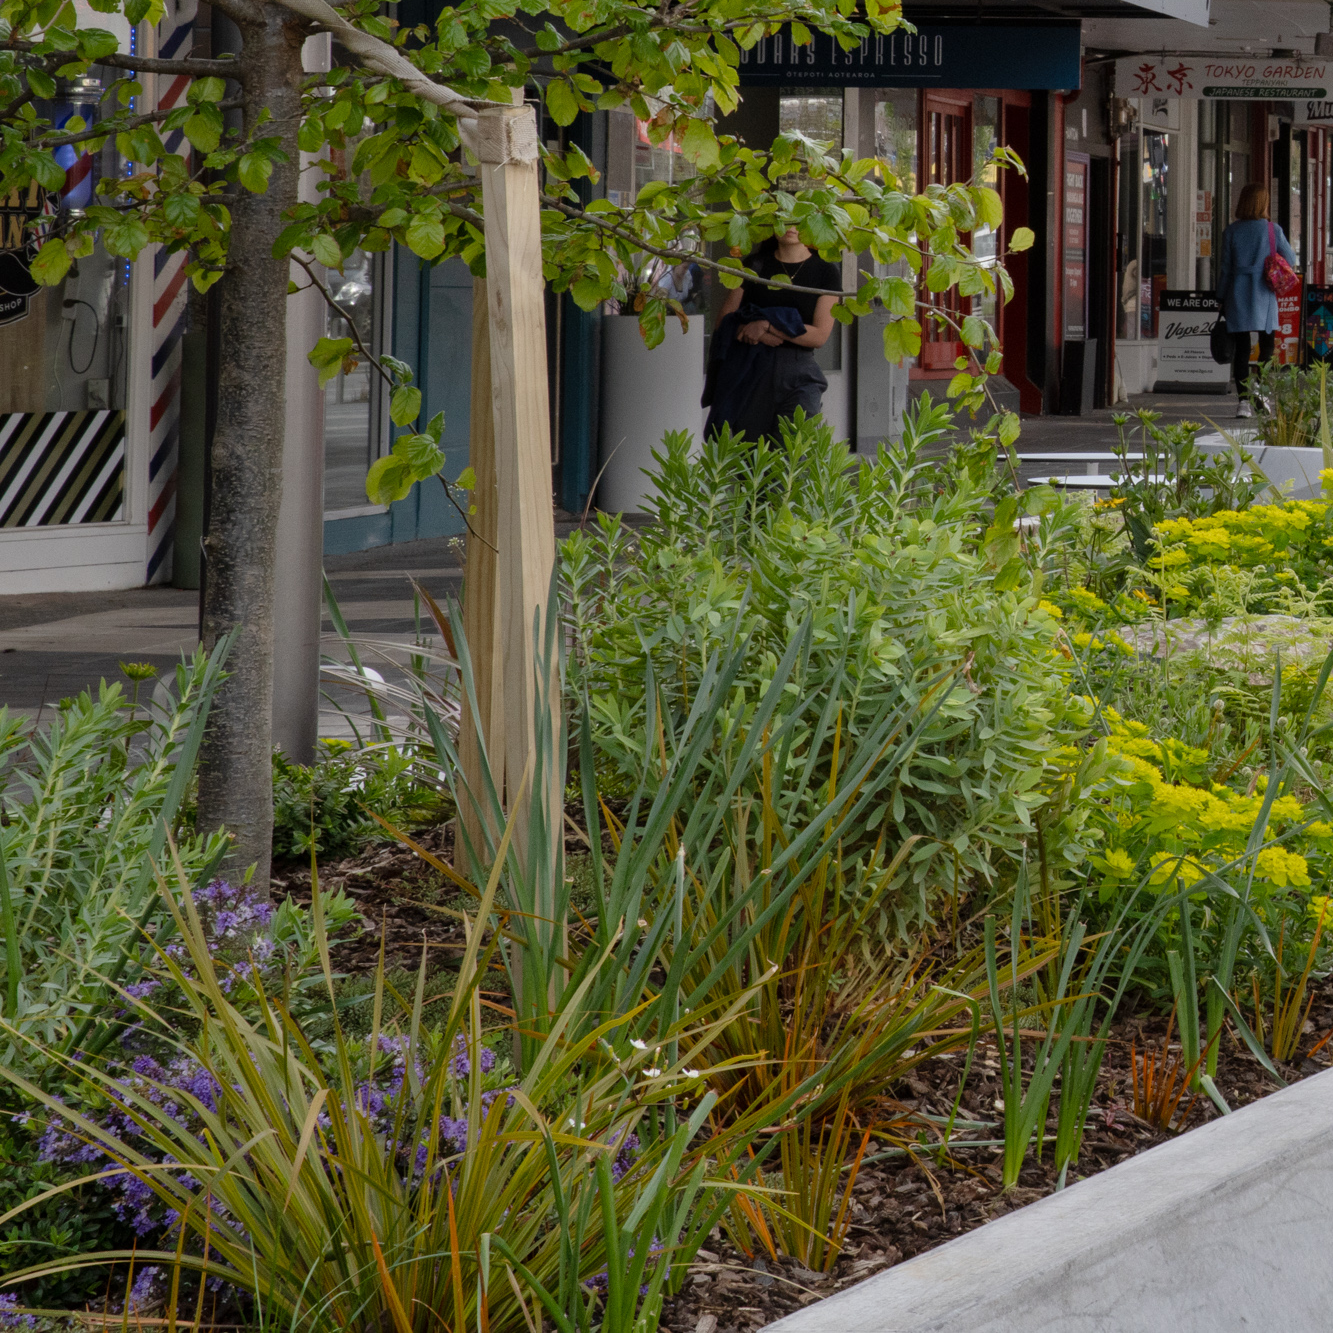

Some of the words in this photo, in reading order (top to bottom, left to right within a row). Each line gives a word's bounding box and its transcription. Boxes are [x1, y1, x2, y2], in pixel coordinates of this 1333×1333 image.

[832, 35, 943, 66] ESPRESSO
[1204, 65, 1255, 79] TOKYO
[1263, 65, 1326, 79] GARDEN
[1133, 62, 1194, 96] 東京
[1242, 79, 1288, 87] TEPPANYAKI
[1209, 88, 1257, 97] JAPANESE
[1259, 88, 1317, 98] RESTAURANT
[1167, 299, 1181, 307] WE
[1182, 299, 1201, 307] ARE
